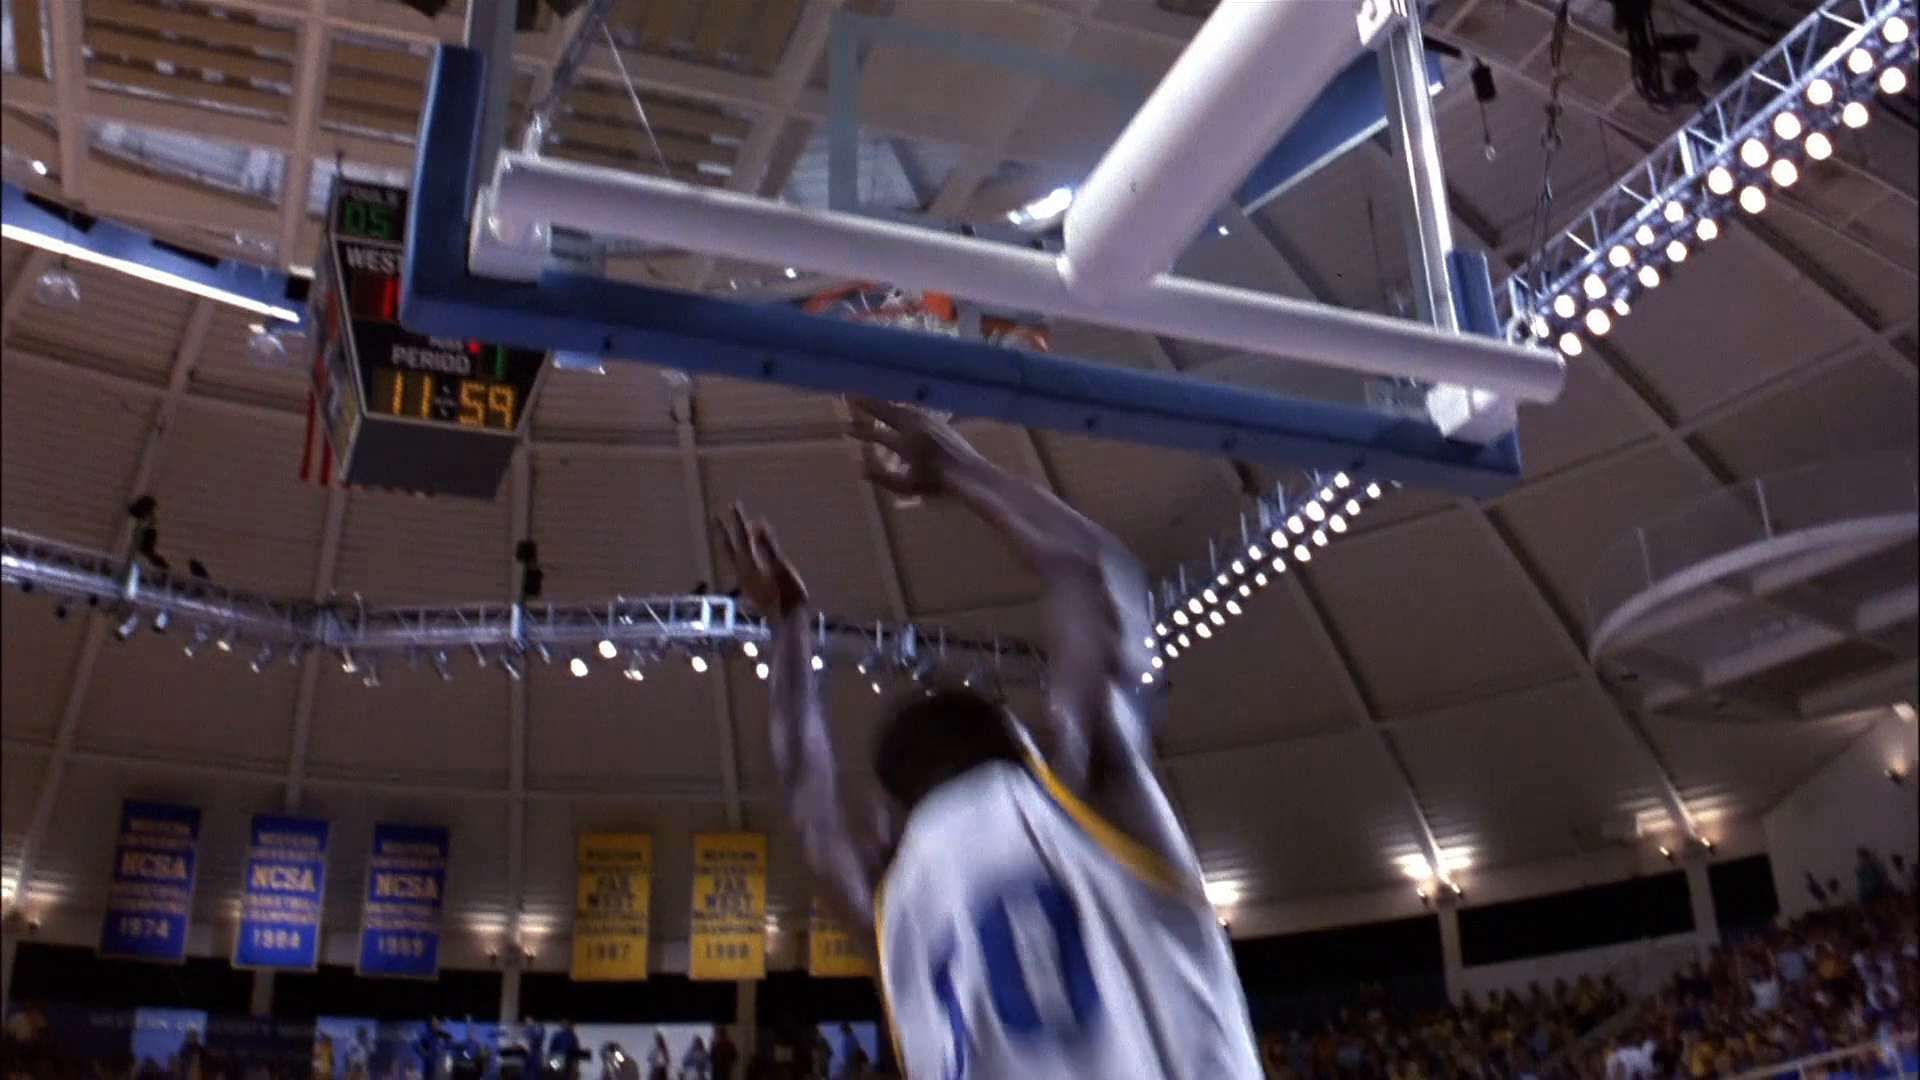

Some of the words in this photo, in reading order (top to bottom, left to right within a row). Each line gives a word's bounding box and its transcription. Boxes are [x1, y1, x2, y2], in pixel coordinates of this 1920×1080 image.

[391, 344, 471, 374] PERIOD
[121, 851, 188, 881] NCSA
[251, 864, 317, 893] NCSA
[375, 873, 439, 899] NCSA
